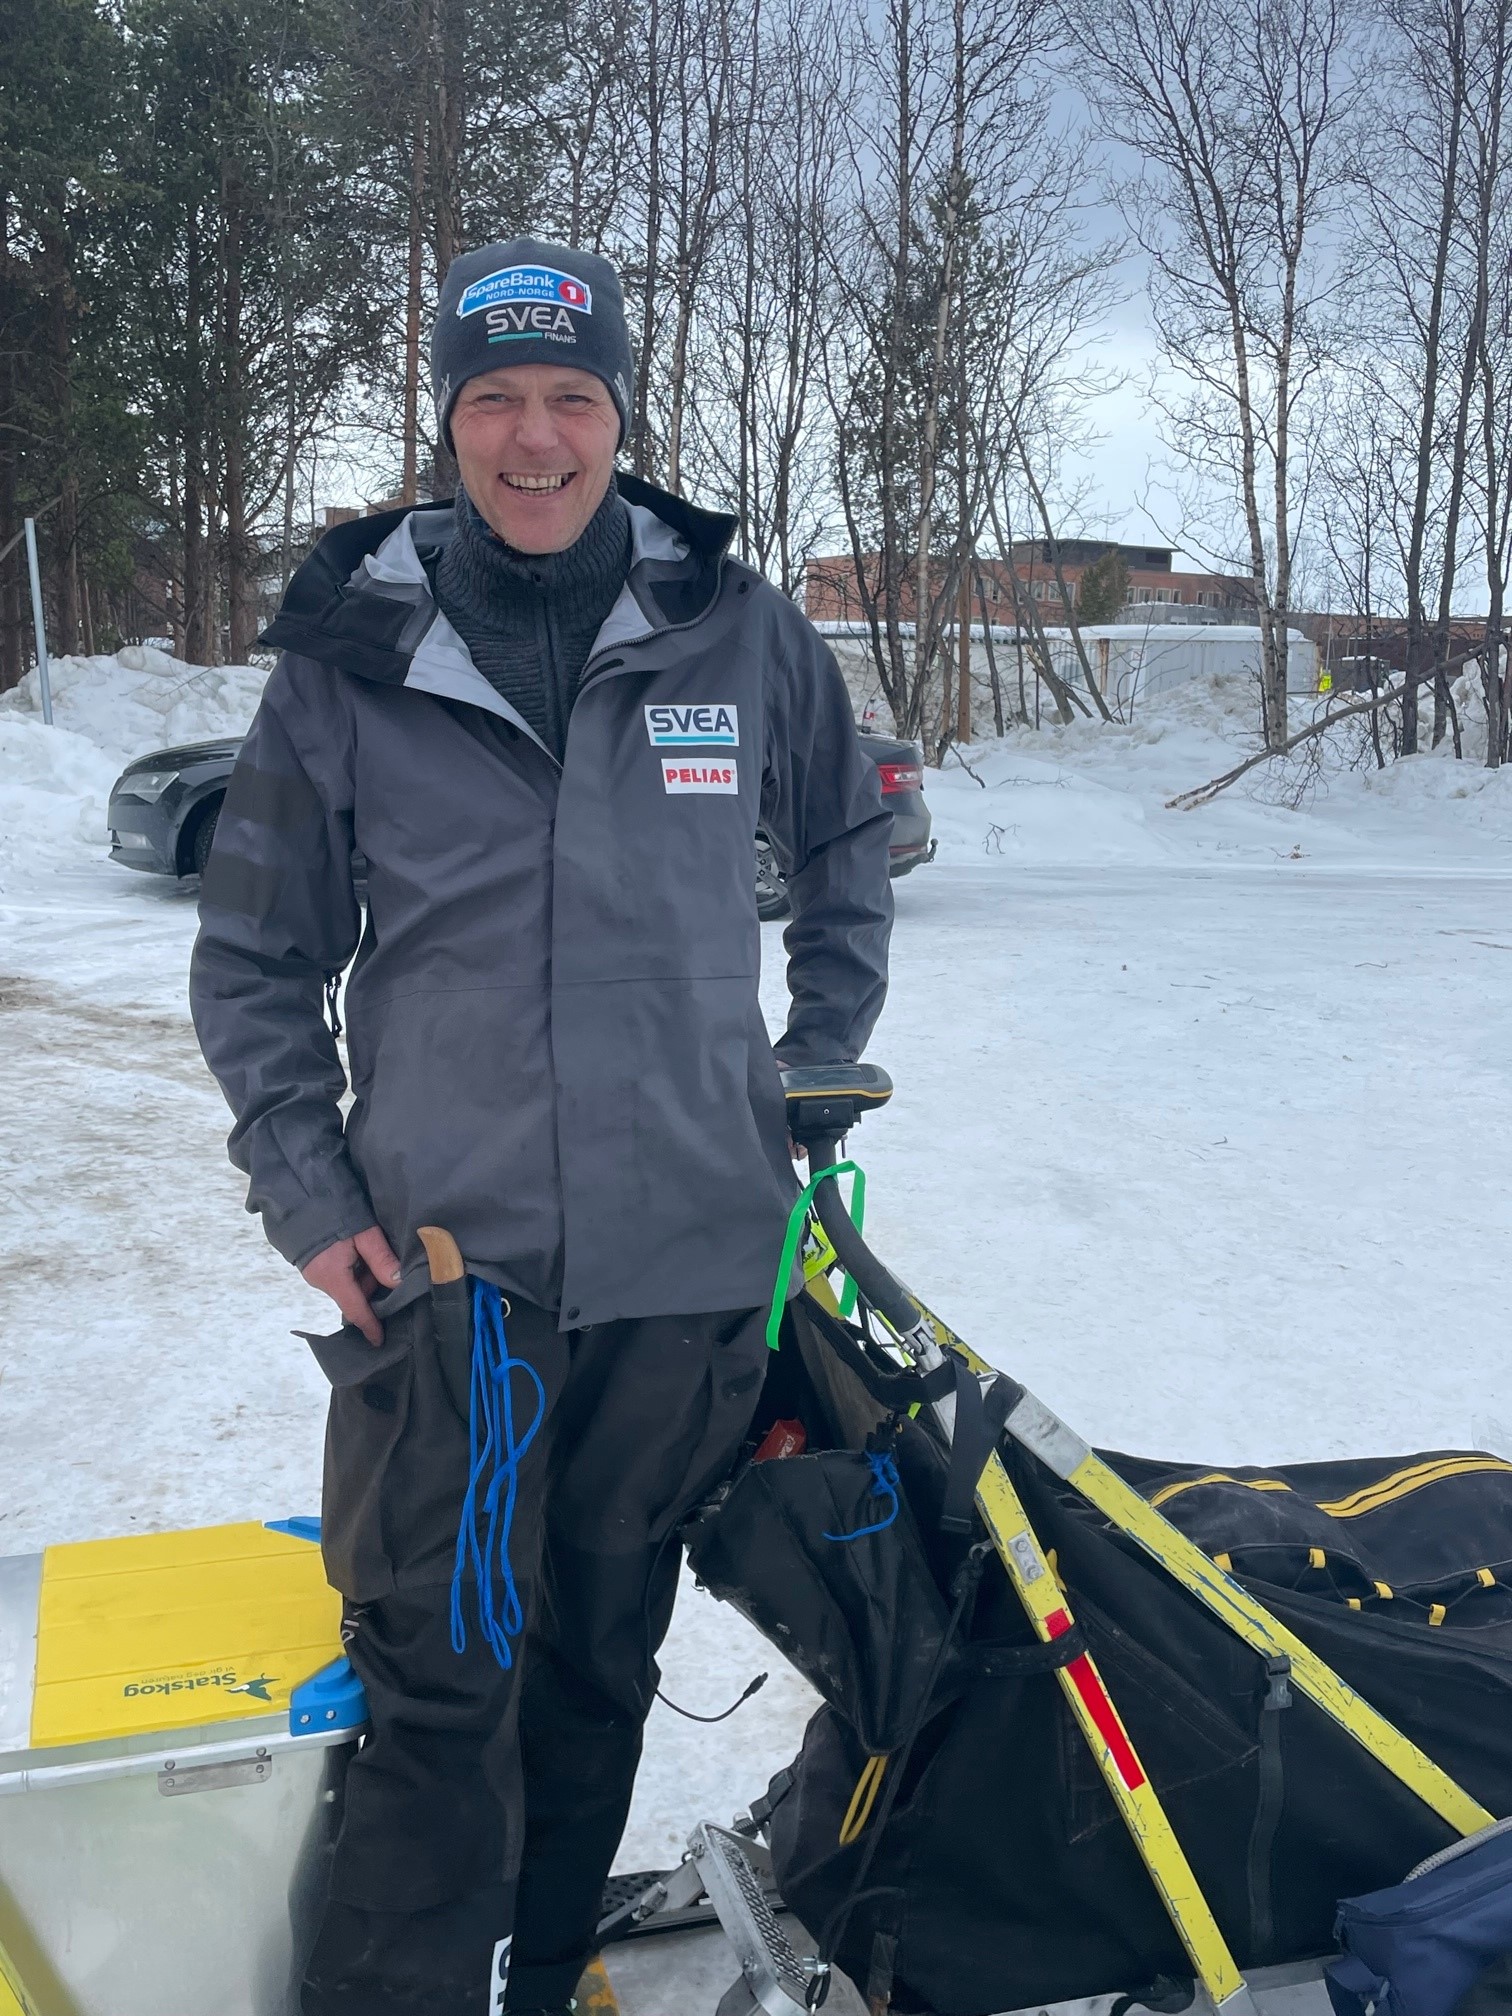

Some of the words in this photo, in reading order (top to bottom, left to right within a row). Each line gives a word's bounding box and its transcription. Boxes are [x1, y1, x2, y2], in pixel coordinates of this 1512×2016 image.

[465, 272, 555, 300] SpareBank
[567, 285, 577, 300] 1
[485, 287, 555, 301] NORD-NORGE
[485, 305, 576, 335] SVEA
[544, 331, 577, 344] FINANS
[649, 707, 735, 733] SVEA
[665, 768, 732, 784] PELIAS
[123, 1672, 238, 1698] Statskog
